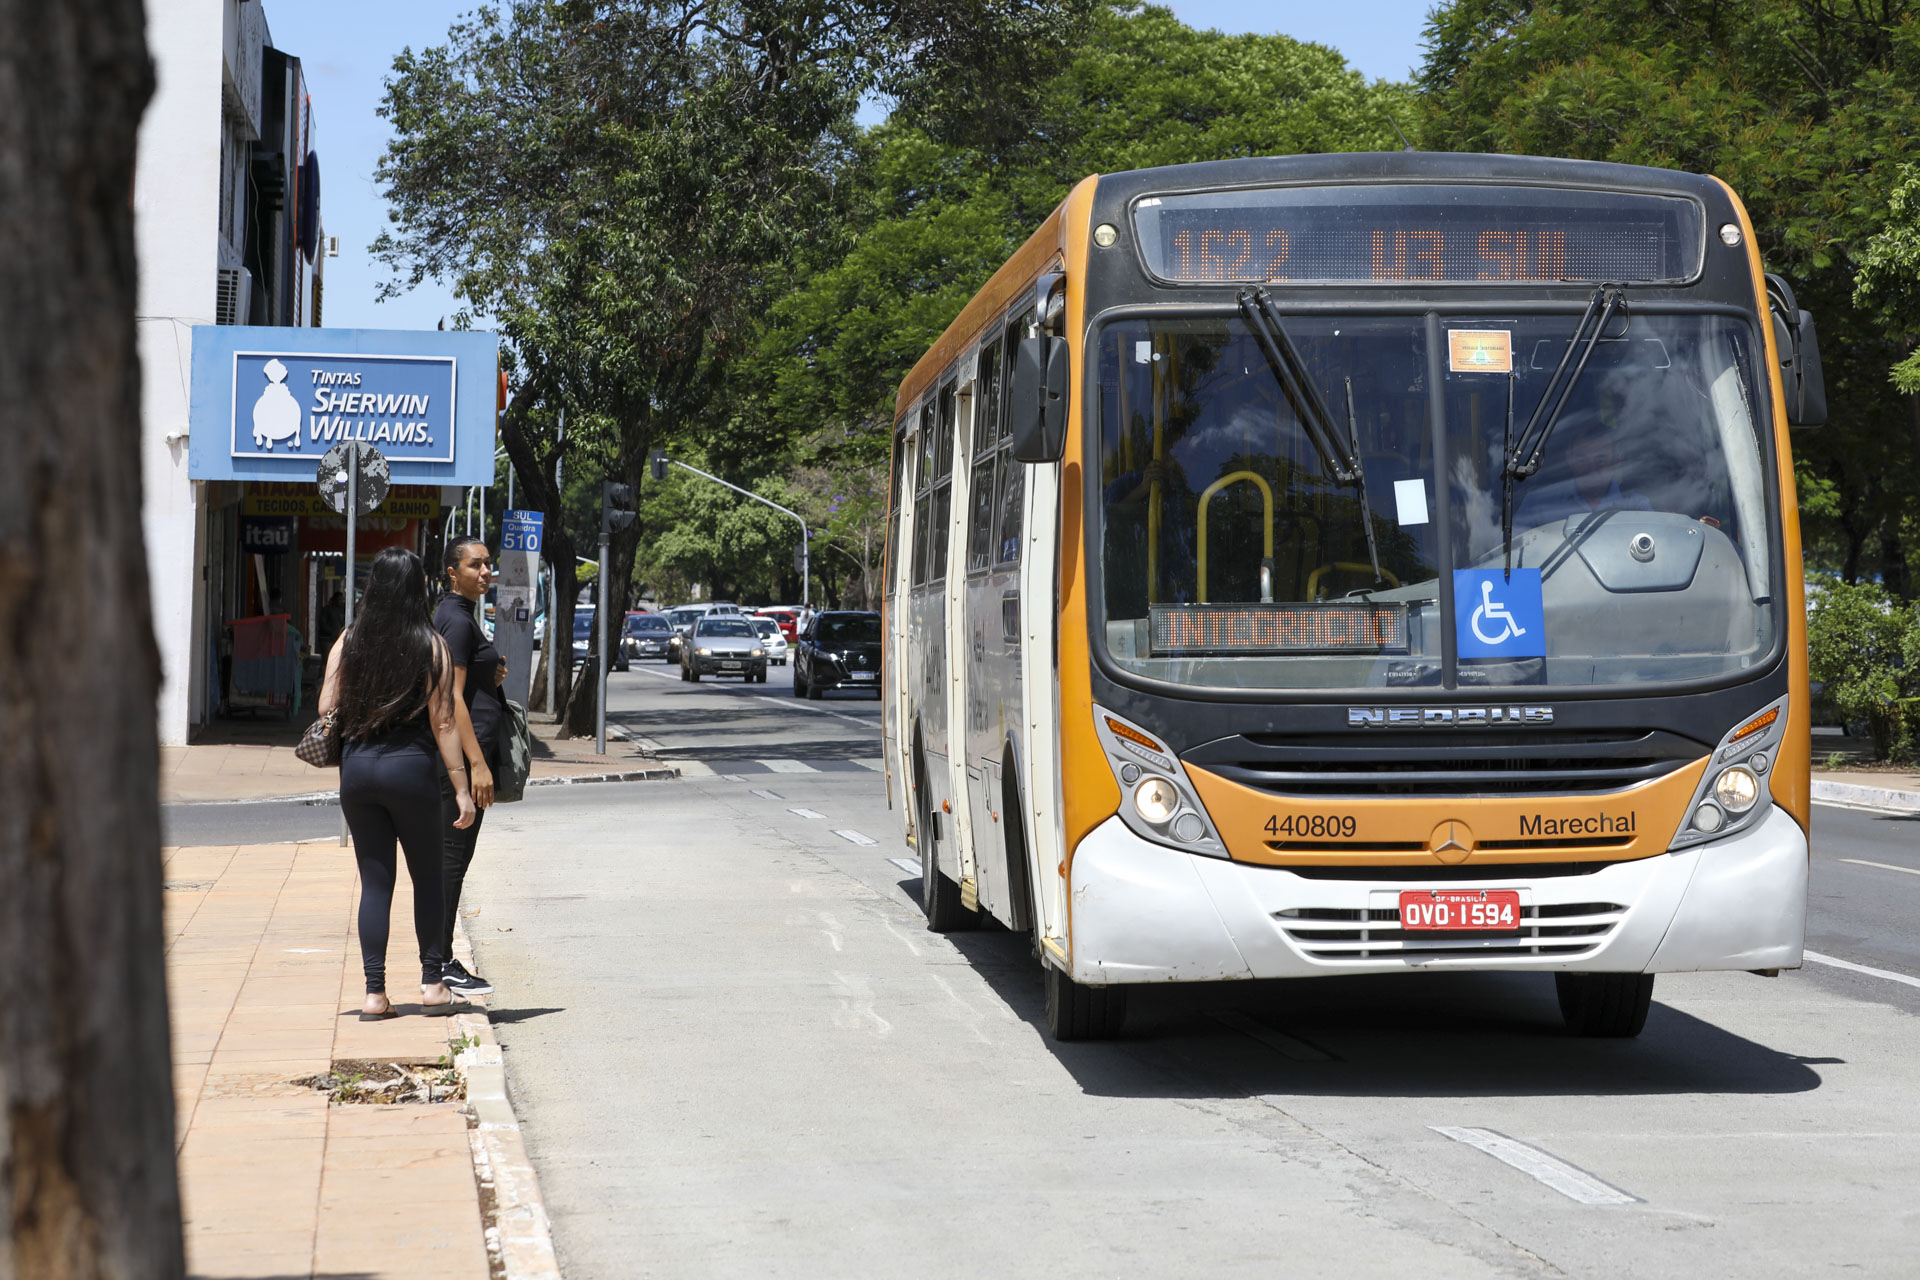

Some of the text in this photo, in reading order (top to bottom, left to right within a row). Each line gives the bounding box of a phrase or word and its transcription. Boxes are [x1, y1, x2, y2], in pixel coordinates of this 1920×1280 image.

[1477, 230, 1583, 280] SUL
[311, 369, 362, 386] TINTAS
[311, 387, 430, 415] SHERWIN
[390, 501, 430, 515] BANHO
[513, 511, 533, 521] SUL
[245, 524, 289, 546] itaú
[508, 523, 536, 533] Quadra
[503, 533, 538, 550] 510
[1167, 610, 1395, 646] INTEGRACAO
[1348, 706, 1554, 727] NEOBUS
[1263, 810, 1636, 838] 440809 Marechal
